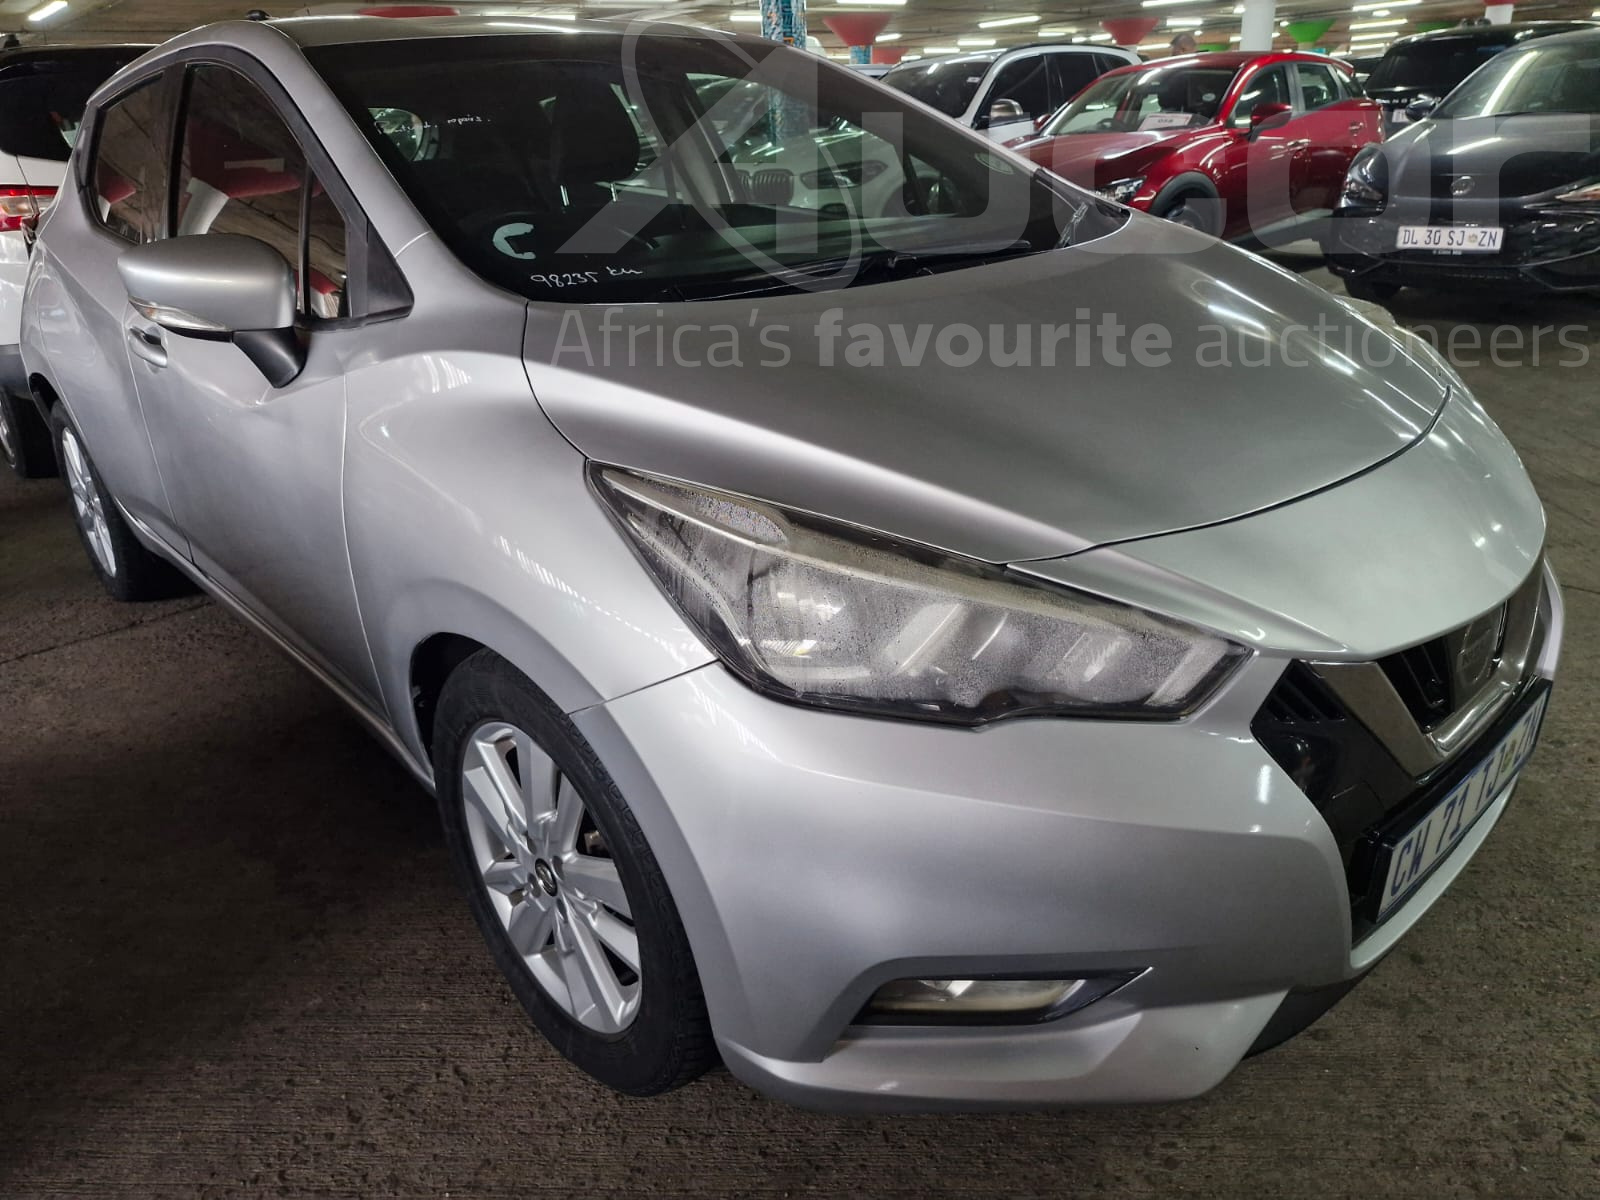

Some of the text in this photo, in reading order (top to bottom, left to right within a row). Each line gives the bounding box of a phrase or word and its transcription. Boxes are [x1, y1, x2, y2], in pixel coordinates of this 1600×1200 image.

[1402, 228, 1497, 248] DL 30 SJ ZN
[1390, 818, 1432, 898] CW
